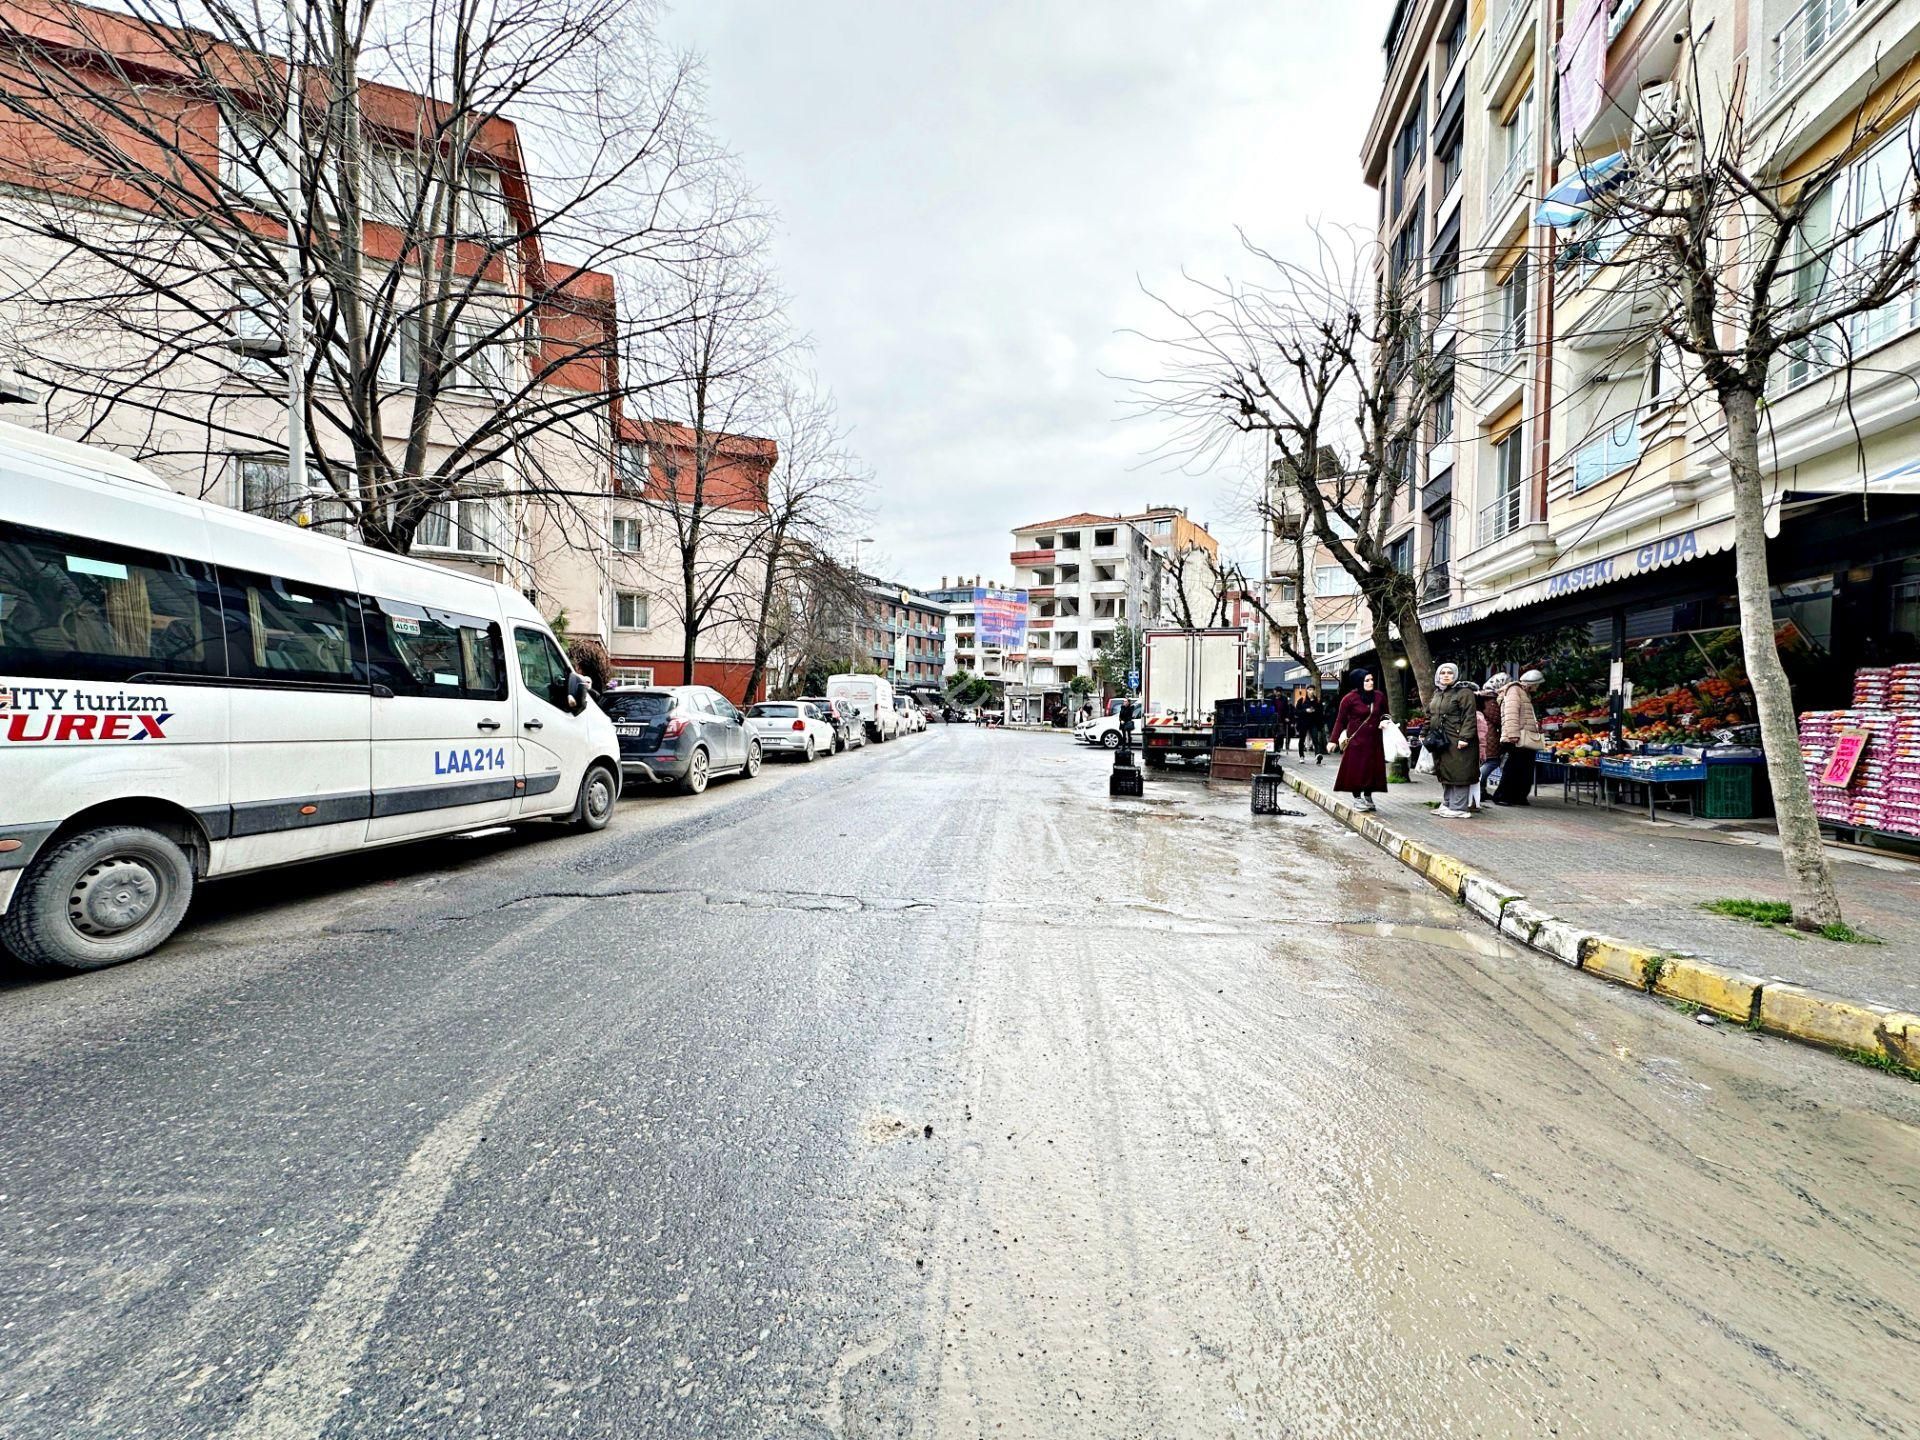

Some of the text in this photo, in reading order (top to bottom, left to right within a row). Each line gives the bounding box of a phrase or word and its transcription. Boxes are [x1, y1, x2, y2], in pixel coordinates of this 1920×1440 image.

[1636, 531, 1698, 569] GIDA
[73, 689, 169, 712] turizm
[434, 747, 505, 775] LAA214
